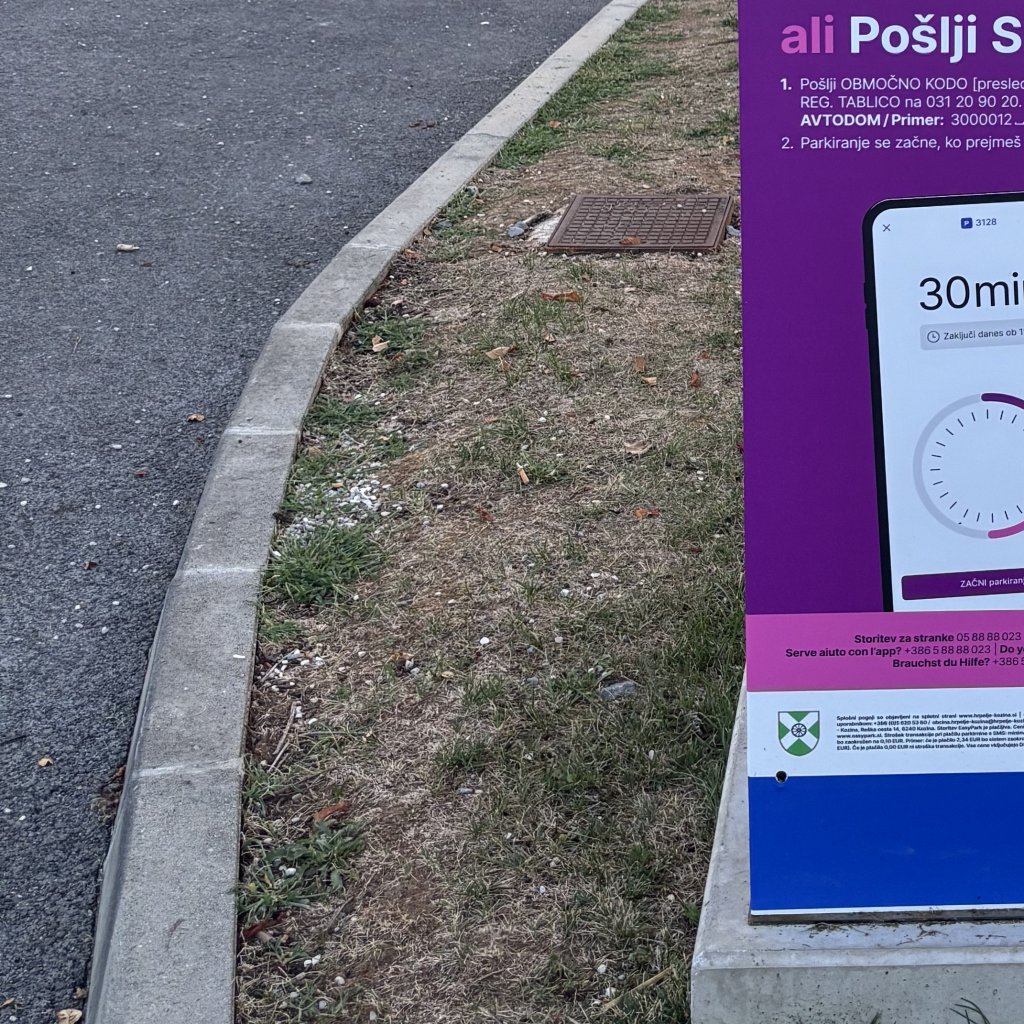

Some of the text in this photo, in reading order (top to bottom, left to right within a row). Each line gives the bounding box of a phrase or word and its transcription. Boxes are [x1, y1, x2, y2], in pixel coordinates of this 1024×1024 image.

[781, 15, 834, 54] ali
[849, 13, 978, 64] Pošlji
[780, 78, 792, 91] 1.
[800, 77, 837, 92] Pošlji
[841, 75, 921, 90] OBMOČNO
[925, 78, 967, 90] KODO
[800, 96, 1022, 108] REG. TABLICO na 031 20 90 20.
[800, 114, 881, 126] AVTODOM
[883, 114, 890, 127] /
[891, 114, 944, 126] Primer:
[781, 137, 793, 149] 2.
[800, 137, 870, 151] Parkiranje
[874, 140, 891, 149] se
[895, 136, 941, 151] začne,
[945, 137, 961, 149] ko
[966, 136, 1021, 151] prejmeš
[976, 218, 997, 227] 3128
[943, 331, 975, 342] Zaključi
[978, 328, 1003, 338] danes
[1006, 328, 1016, 337] ob
[960, 578, 986, 587] ZAČNI
[854, 634, 897, 643] Storitev
[914, 633, 954, 642] stranke
[785, 648, 817, 657] Serve
[819, 648, 846, 657] aiuto
[870, 647, 902, 658] l'app?
[1000, 644, 1015, 654] Do
[893, 658, 941, 668] Brauchst
[943, 658, 957, 667] du
[959, 657, 990, 666] Hilfe?
